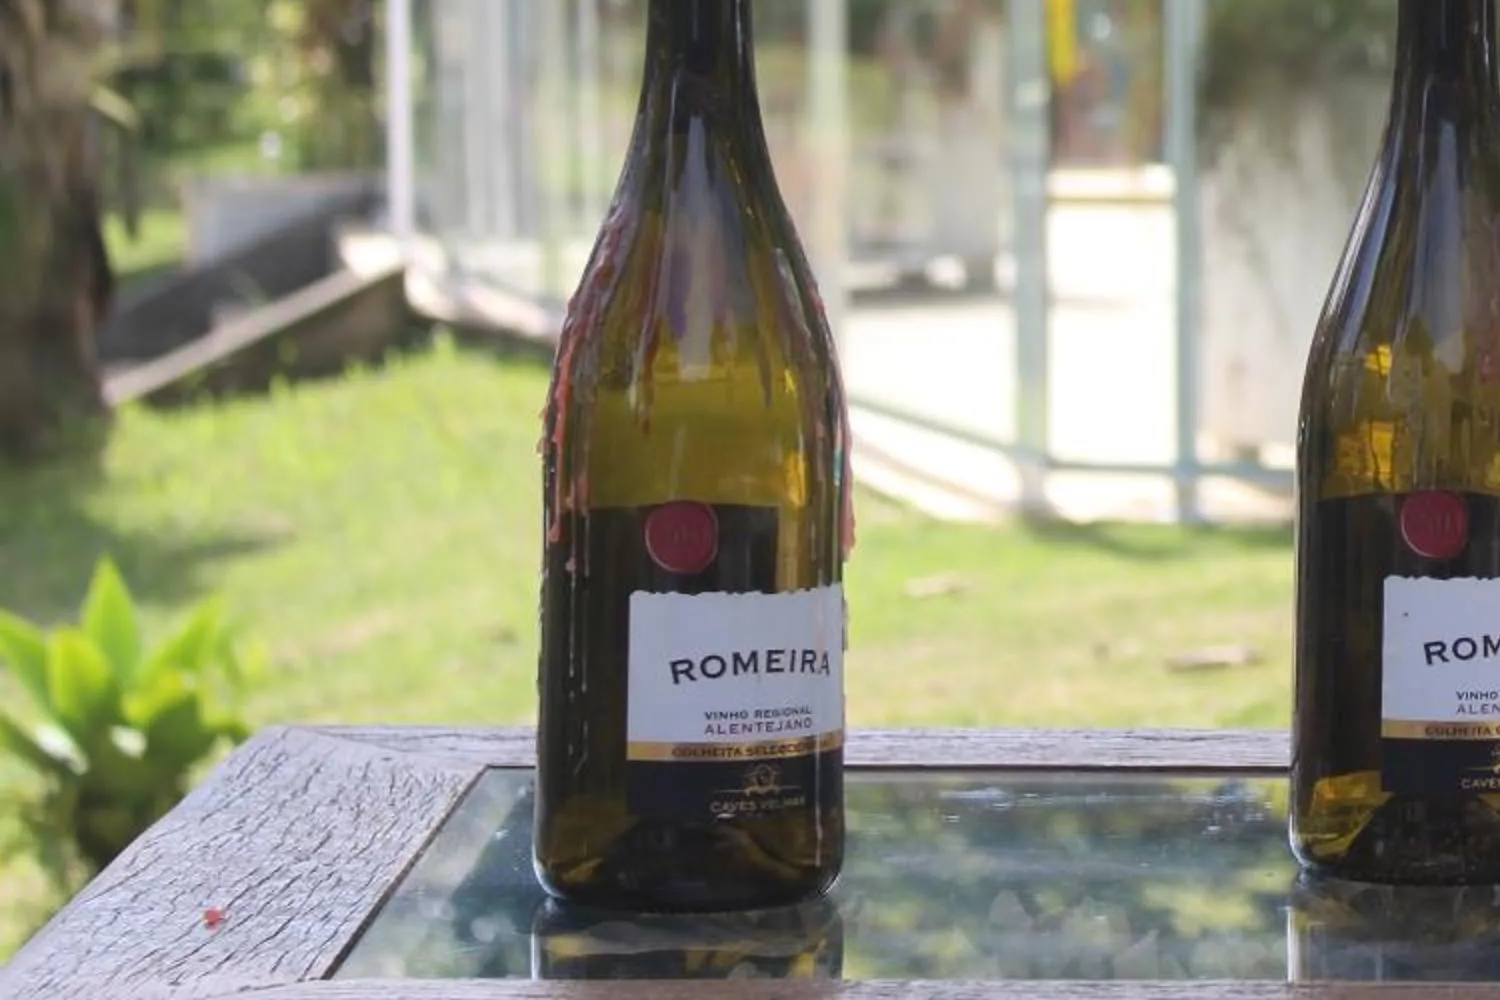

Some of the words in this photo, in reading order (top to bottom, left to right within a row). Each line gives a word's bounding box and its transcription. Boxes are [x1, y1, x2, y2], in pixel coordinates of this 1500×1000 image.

[669, 648, 831, 685] ROMEIRA
[1455, 689, 1499, 702] VINHO
[704, 710, 749, 720] VINHO
[754, 705, 812, 719] REGIONAL
[704, 718, 812, 735] ALENTEJANO
[1424, 724, 1491, 737] COLHEITA
[671, 745, 743, 758] COLHEITA
[710, 801, 757, 813] CAVES
